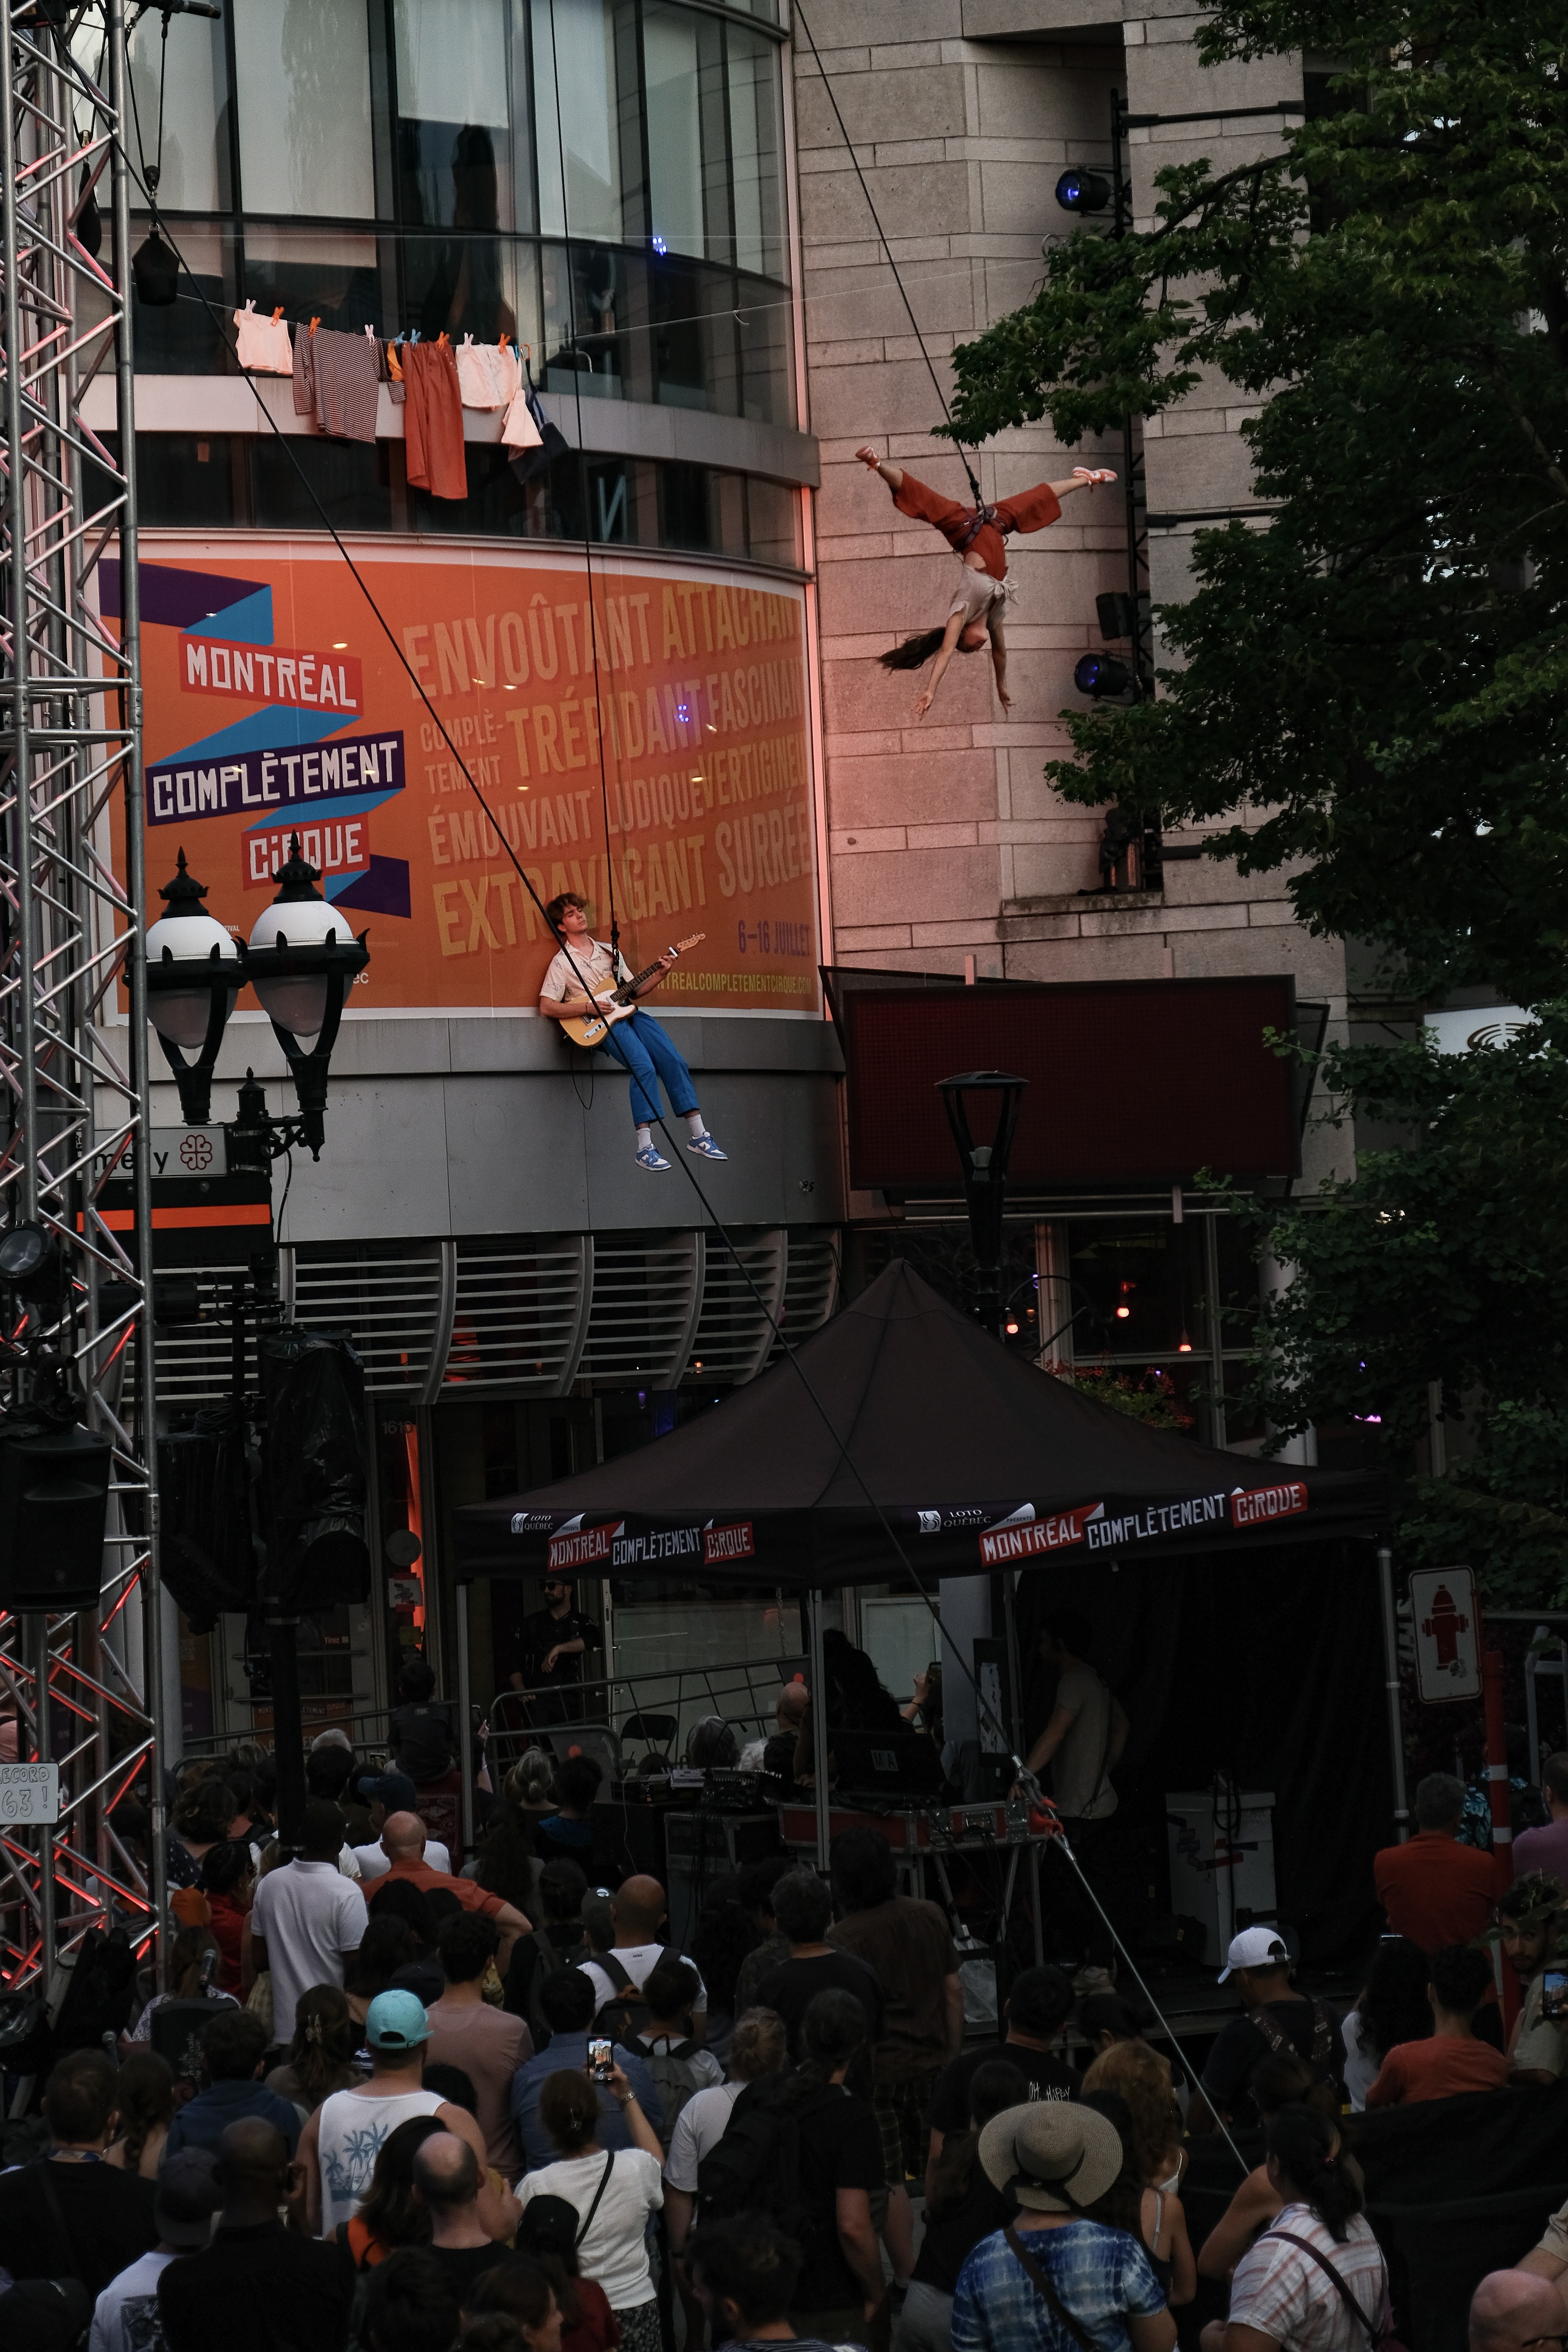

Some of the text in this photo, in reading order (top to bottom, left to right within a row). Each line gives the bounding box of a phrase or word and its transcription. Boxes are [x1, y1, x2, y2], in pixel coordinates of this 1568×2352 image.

[404, 582, 801, 699] ENVOÛTANT ATTACHAN
[186, 643, 357, 708] MONTRÉAL
[506, 657, 802, 777] TRÉPIDANT FASCINAN
[153, 741, 399, 817] COMPLÈTEMENT
[424, 755, 501, 795] TEMENT
[428, 791, 592, 865] ÉMOUVANT
[608, 768, 704, 835] LUDIQUE
[432, 835, 705, 956] EXTRAVAGANT
[774, 921, 809, 956] JUILLET
[658, 972, 812, 994] TREALCOMPLETEMENTCIRQUE.COM
[524, 1522, 553, 1530] QUÉBEC
[944, 1516, 991, 1527] QUÉBEC
[950, 1509, 982, 1518] LOTO
[983, 1516, 1081, 1562] MONTRÉAL
[1087, 1493, 1225, 1550] COMPLÈTEMENT
[550, 1530, 609, 1566] MONTRÉAL
[613, 1527, 700, 1566] COMPLÈTEMENT
[0, 1767, 50, 1784] ECORD
[1046, 2084, 1070, 2102] HAPPY
